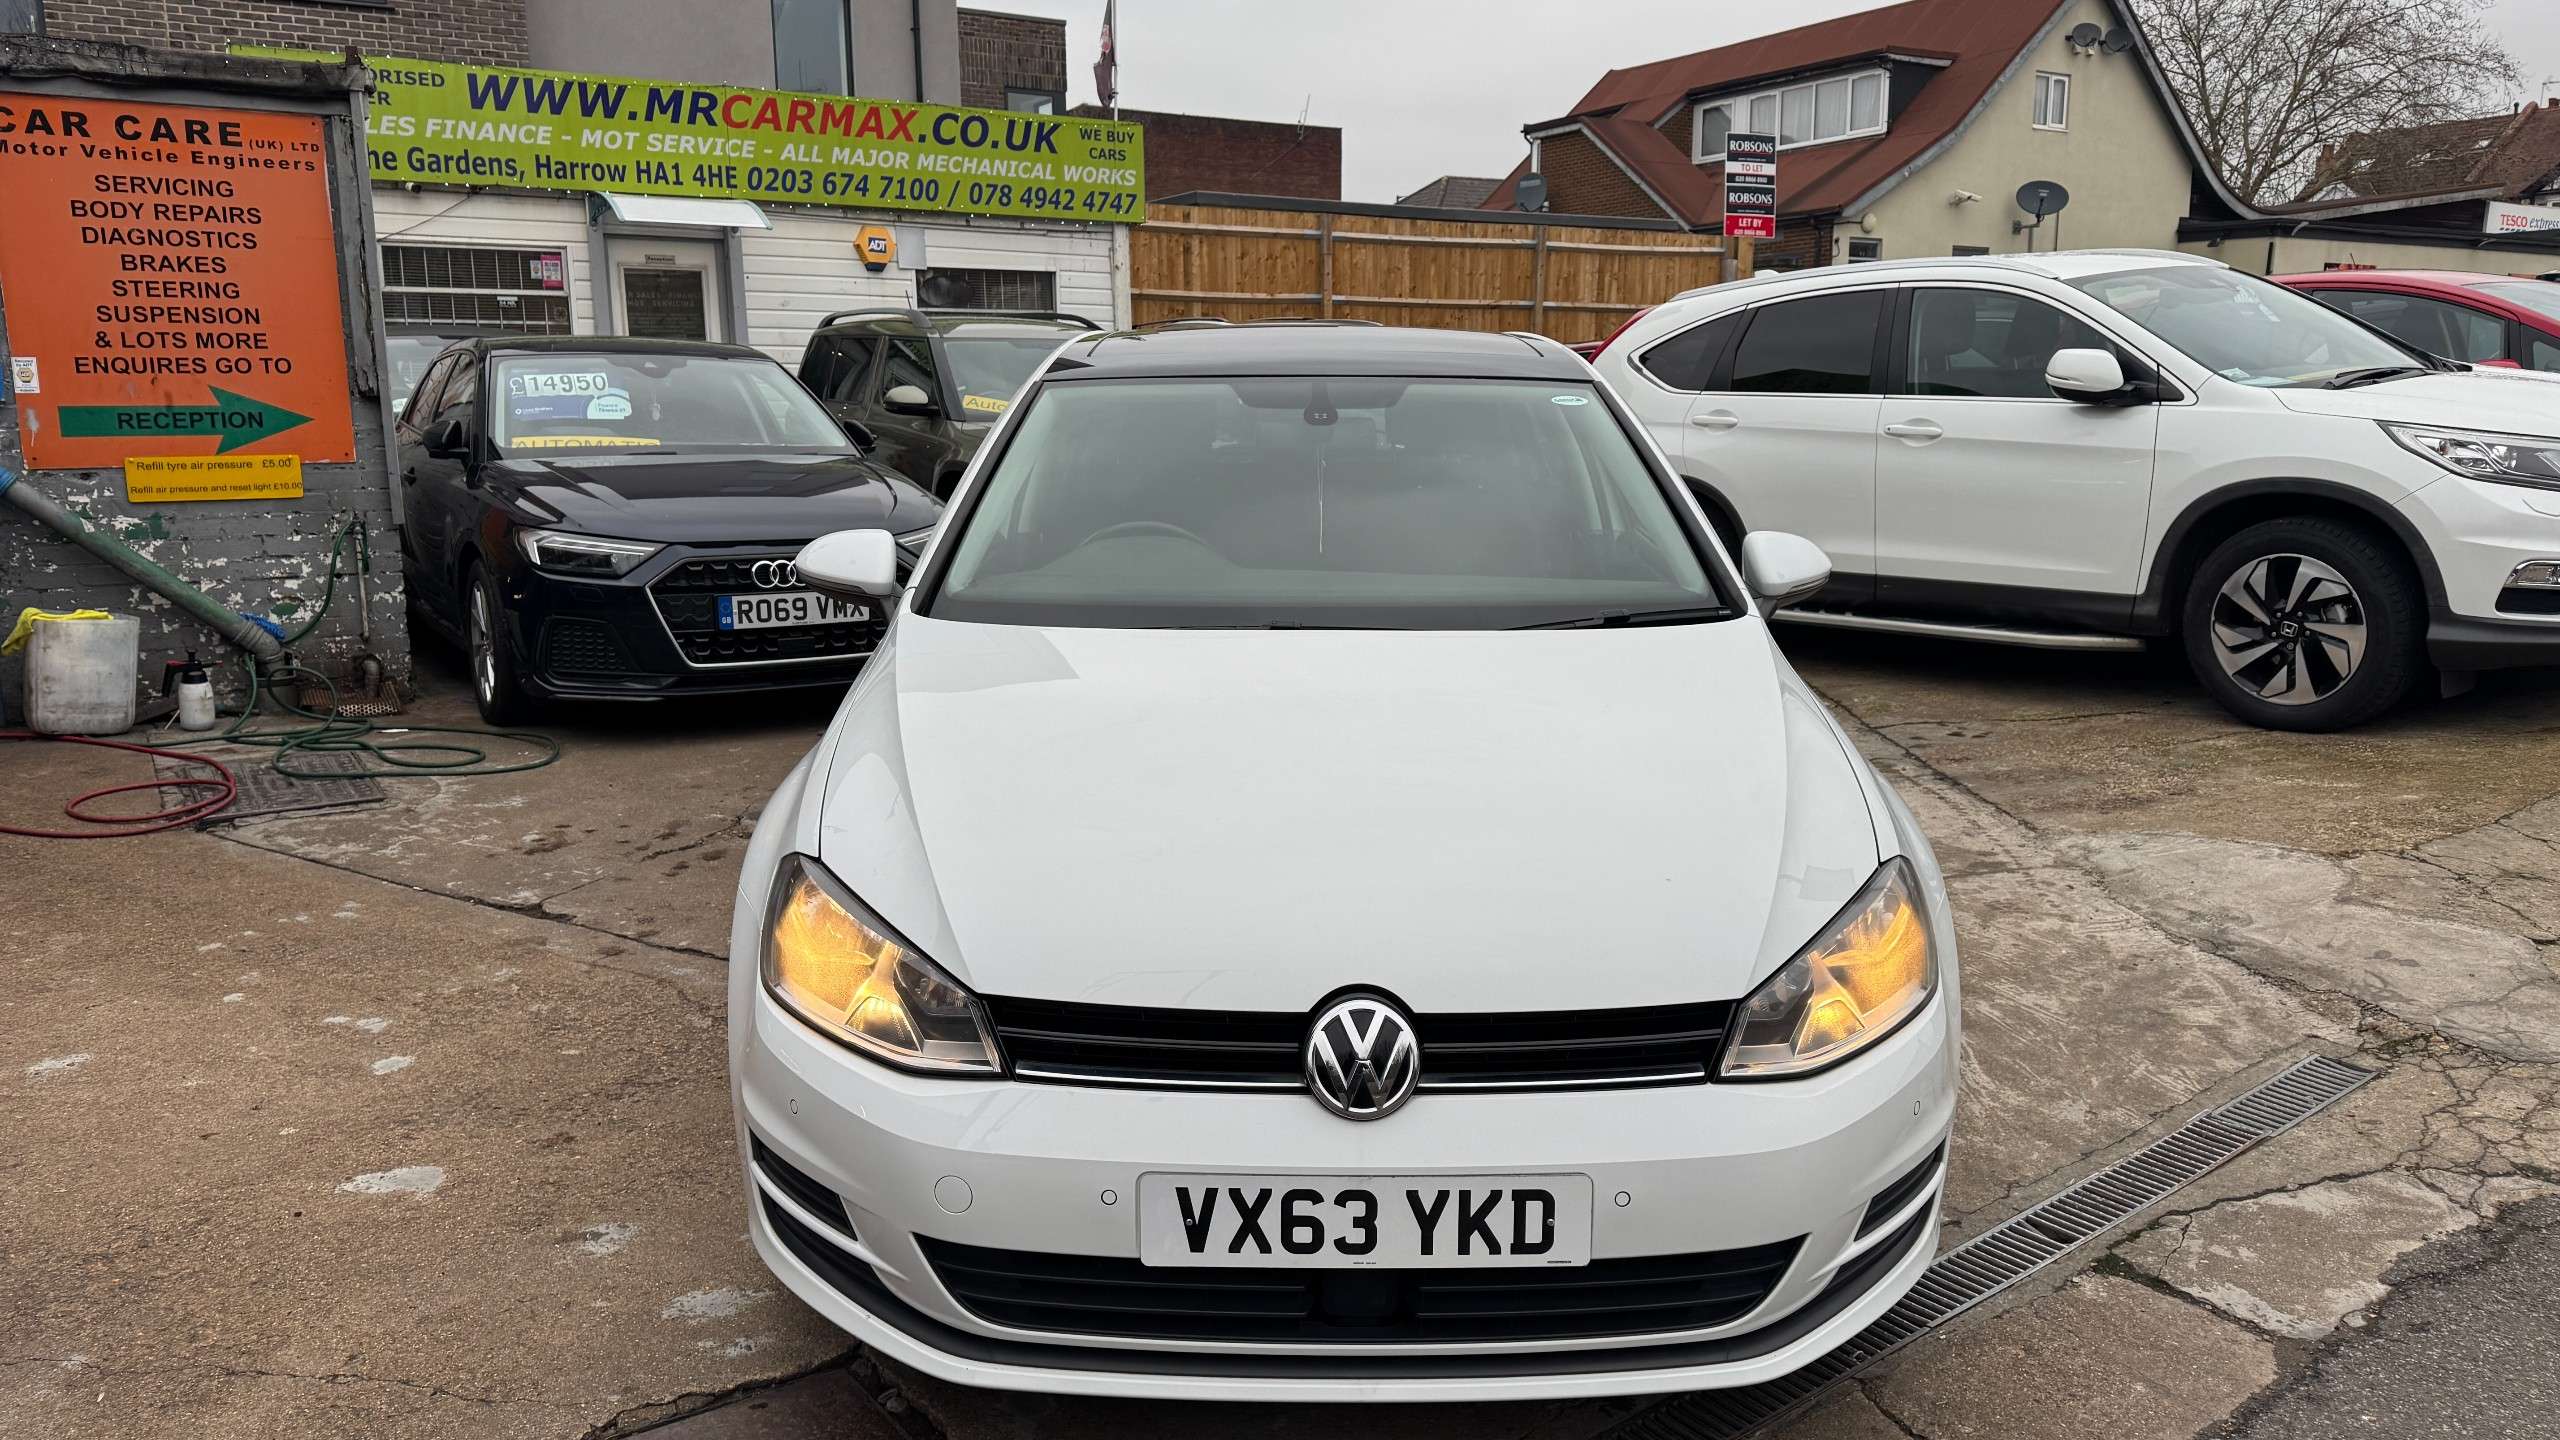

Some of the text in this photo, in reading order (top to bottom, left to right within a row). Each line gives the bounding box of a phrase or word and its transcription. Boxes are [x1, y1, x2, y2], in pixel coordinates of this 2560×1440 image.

[467, 72, 1062, 155] WWW.MRCARMAX.CO.UK
[0, 105, 320, 153] CAR CARE (UK) LTD
[1079, 127, 1135, 145] WE BUY
[425, 118, 553, 145] FINANCE
[581, 128, 640, 151] MOT
[646, 133, 757, 159] SERVICE
[780, 142, 823, 163] ALL
[831, 146, 910, 169] MAJOR
[916, 153, 1056, 181] MECHANICAL
[1063, 164, 1137, 186] WORKS
[1089, 147, 1127, 162] CARS
[1729, 140, 1773, 153] ROBSONS
[80, 143, 178, 163] Vehicle
[191, 150, 316, 172] Engineers
[1741, 163, 1763, 172] TO LET
[94, 174, 235, 198] SERVICING
[407, 146, 525, 183] Gardens,
[535, 153, 627, 183] Harrow
[635, 159, 684, 186] HA1
[692, 163, 738, 189] 4HE
[747, 166, 813, 195] 0203
[822, 171, 870, 198] 674
[879, 175, 939, 202] 7100
[969, 181, 1013, 208] 078
[1020, 185, 1075, 211] 4942
[1082, 190, 1137, 215] 4747
[1729, 192, 1773, 205] ROBSONS
[70, 199, 262, 225] BODY REPAIRS
[2500, 214, 2528, 228] TESCO
[1739, 217, 1763, 227] LET BY
[81, 226, 257, 250] DIAGNOSTICS
[868, 239, 887, 252] ADT
[120, 254, 227, 274] BRAKES
[112, 279, 240, 299] STEERING
[96, 305, 261, 325] SUSPENSION
[95, 331, 269, 349] & LOTS MORE
[74, 356, 292, 375] ENQUIRES GO TO
[116, 411, 264, 430] RECEPTION
[136, 458, 292, 472] Refill tyre air pressure £5.00
[130, 486, 153, 494] Refill
[169, 485, 208, 495] pressure
[211, 484, 227, 493] and
[229, 484, 251, 493] reset
[253, 482, 272, 492] light
[737, 597, 808, 625] RO69
[1175, 1186, 1556, 1256] VX63 YKD
